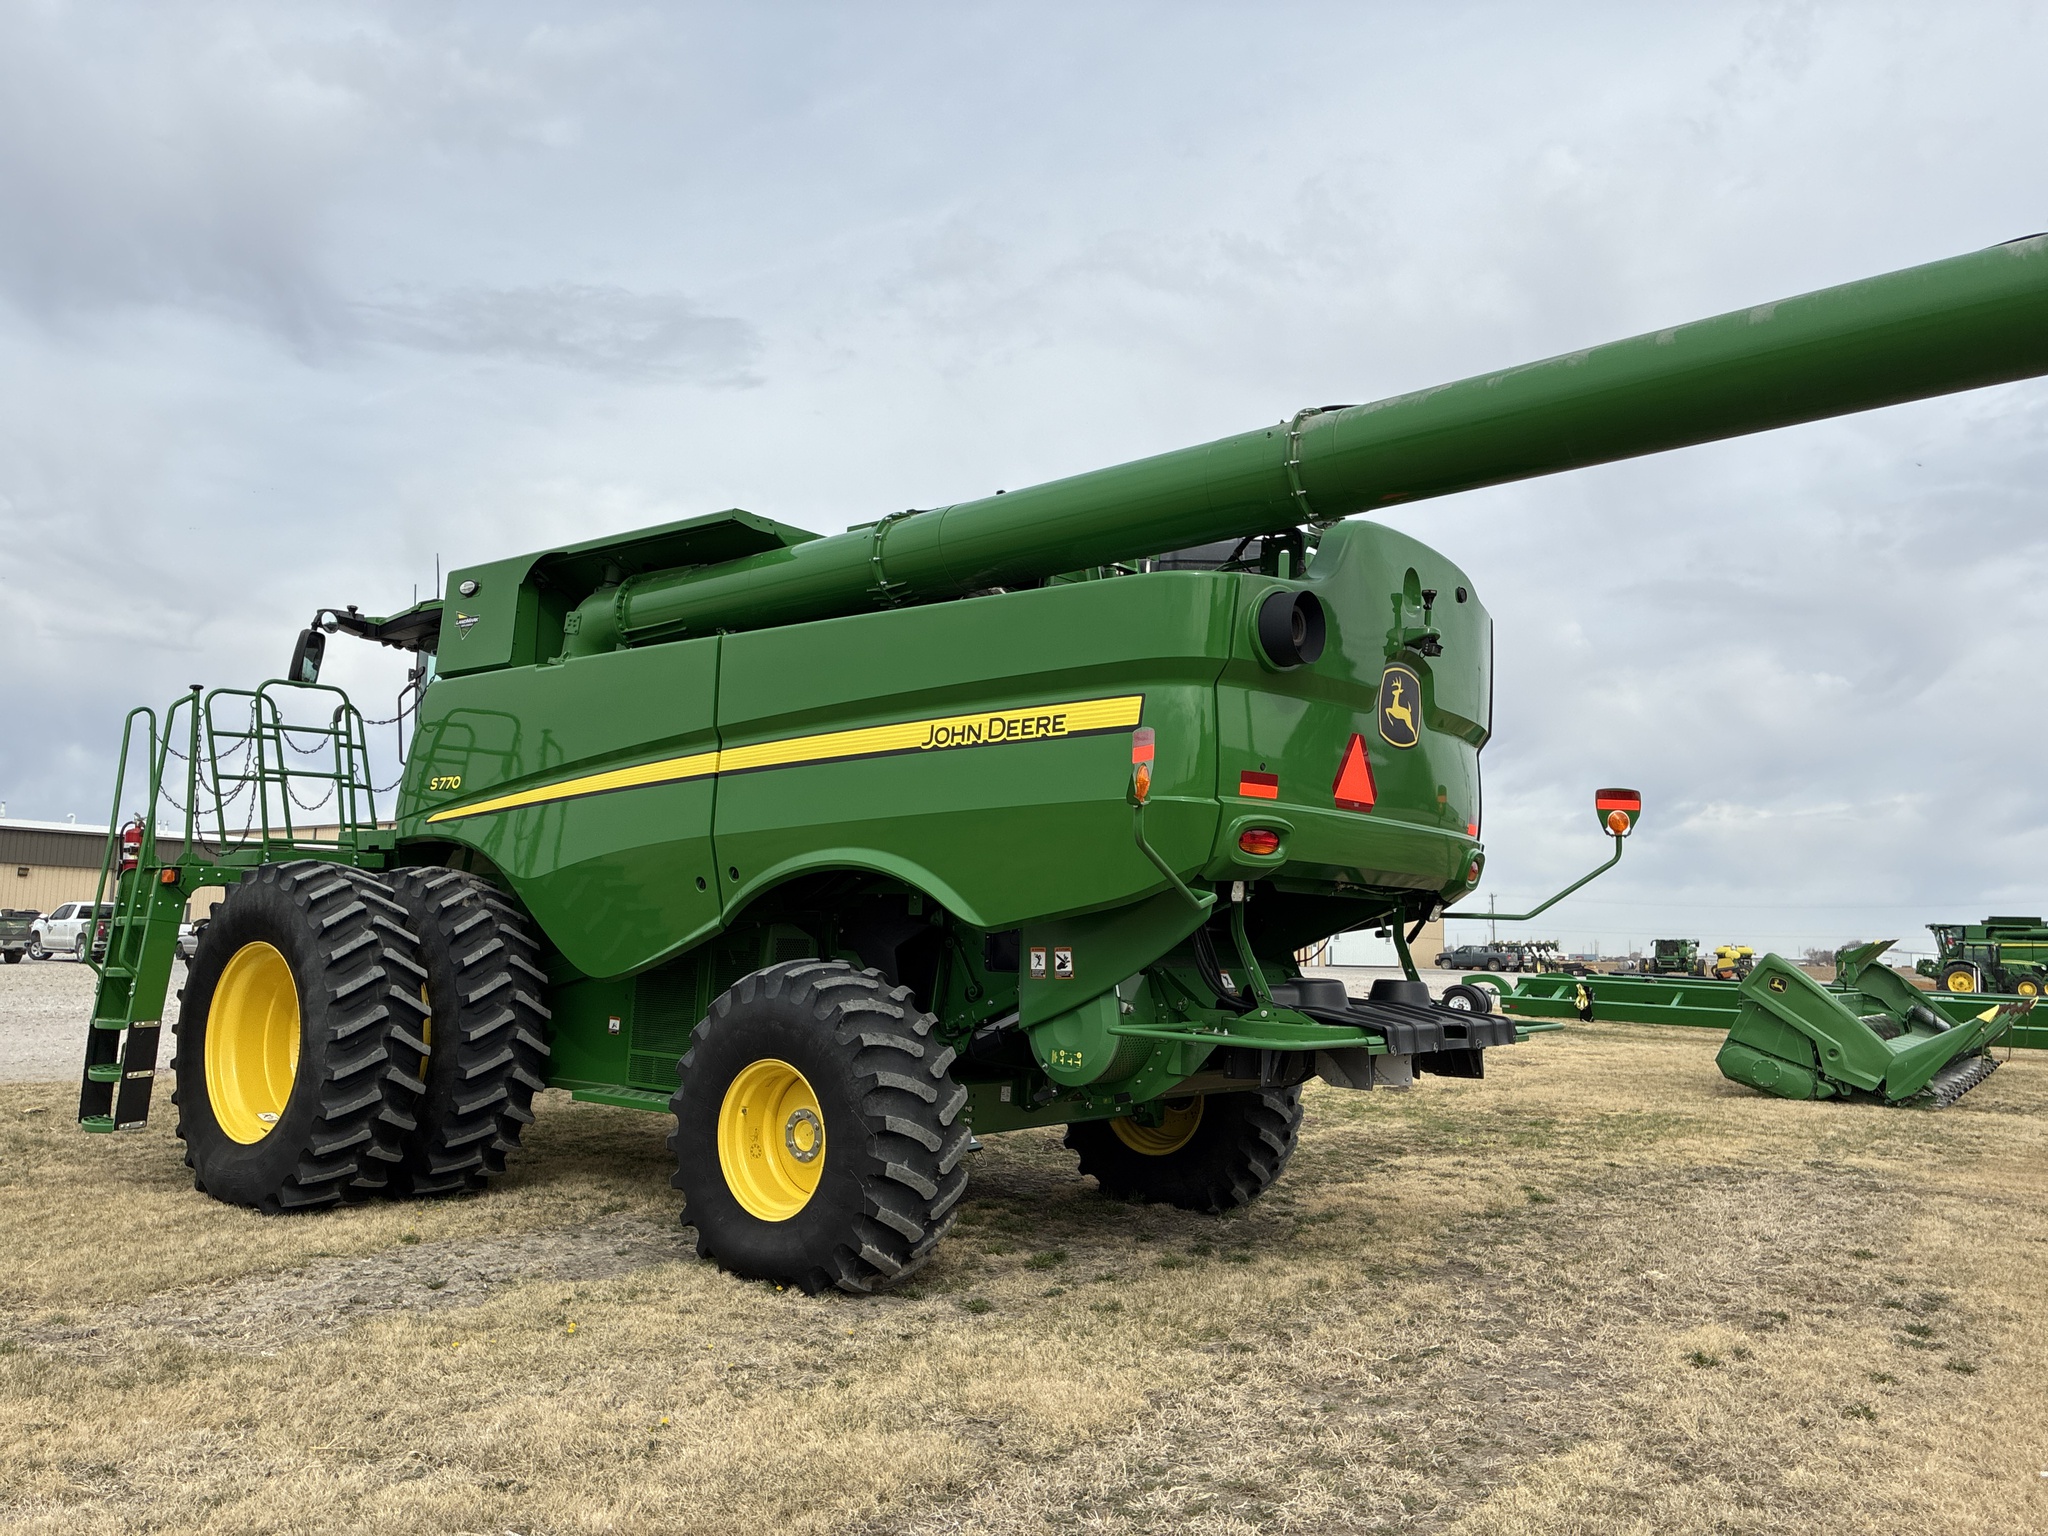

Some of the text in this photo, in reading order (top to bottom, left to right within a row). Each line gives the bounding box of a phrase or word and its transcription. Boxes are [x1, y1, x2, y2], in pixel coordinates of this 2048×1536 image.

[921, 713, 1067, 747] JOHN DEERE
[429, 775, 462, 791] S770
